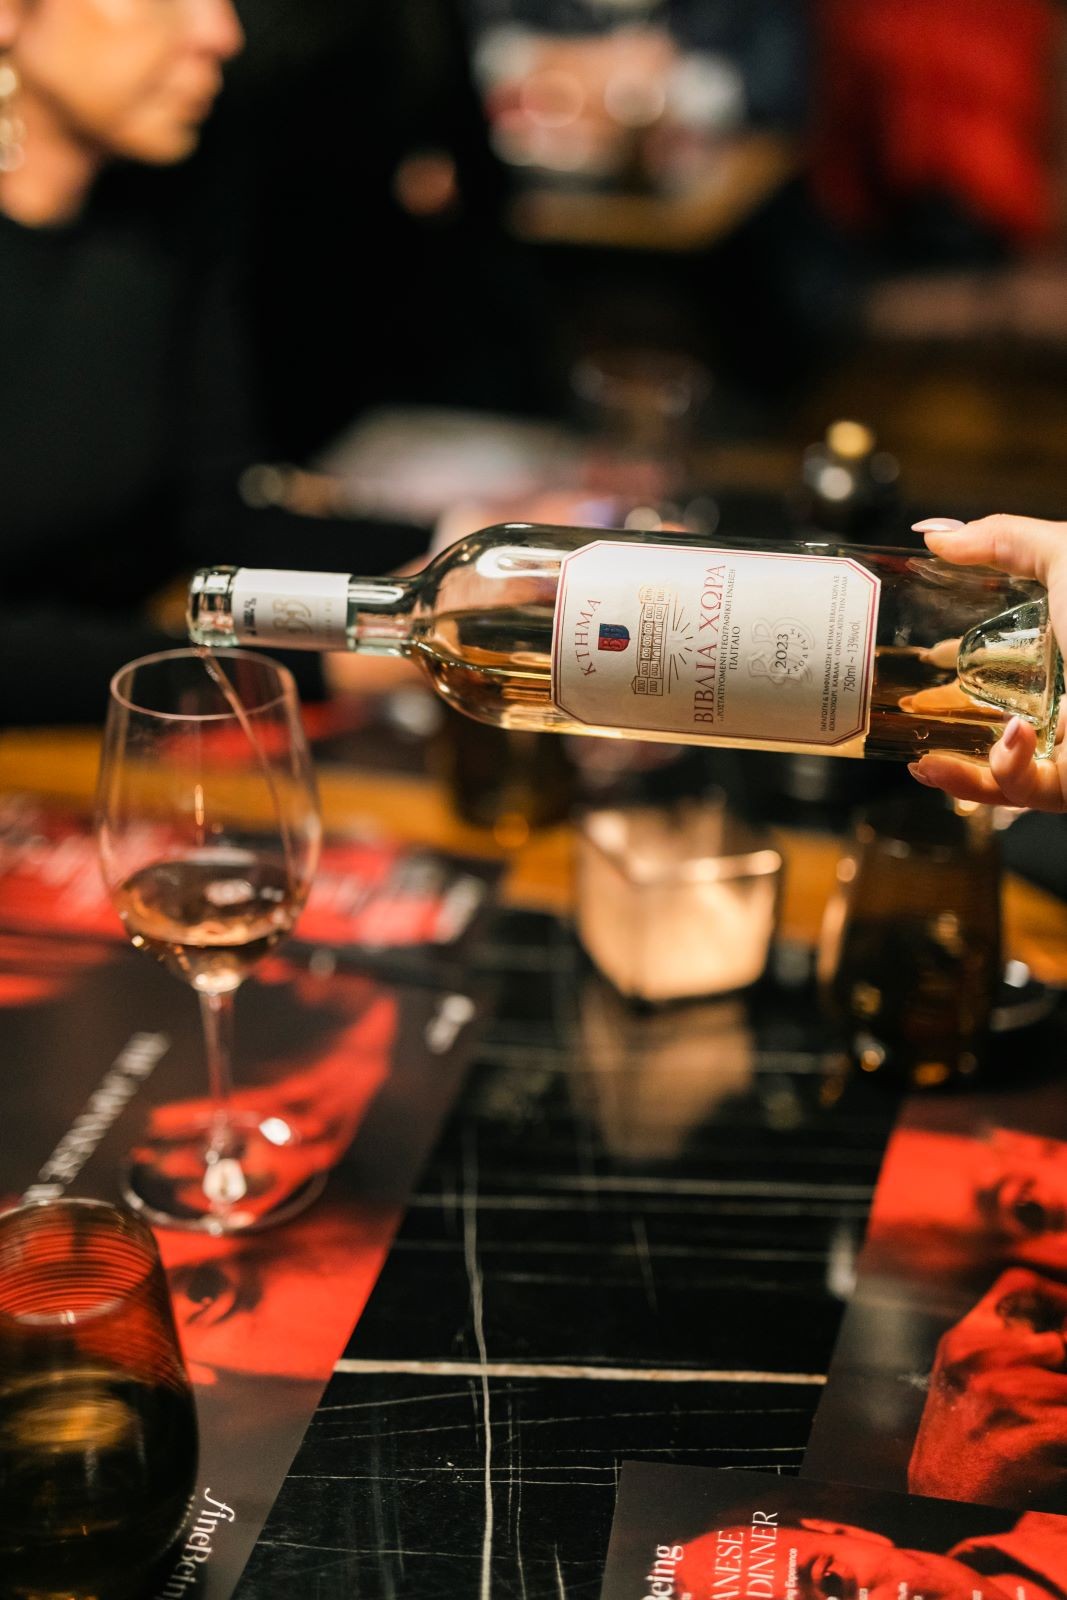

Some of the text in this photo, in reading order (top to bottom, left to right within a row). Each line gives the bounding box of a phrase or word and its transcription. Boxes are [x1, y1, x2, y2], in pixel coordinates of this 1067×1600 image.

[575, 599, 602, 677] ΚΤΗΜΑ
[694, 565, 726, 724] ΒΙΒΛΙΑ ΧΩΡΑ
[728, 626, 741, 671] ΠΑΓΓΑΙΟ
[774, 633, 789, 669] 2023
[844, 664, 857, 692] 750ml
[746, 1511, 778, 1599] DINNER
